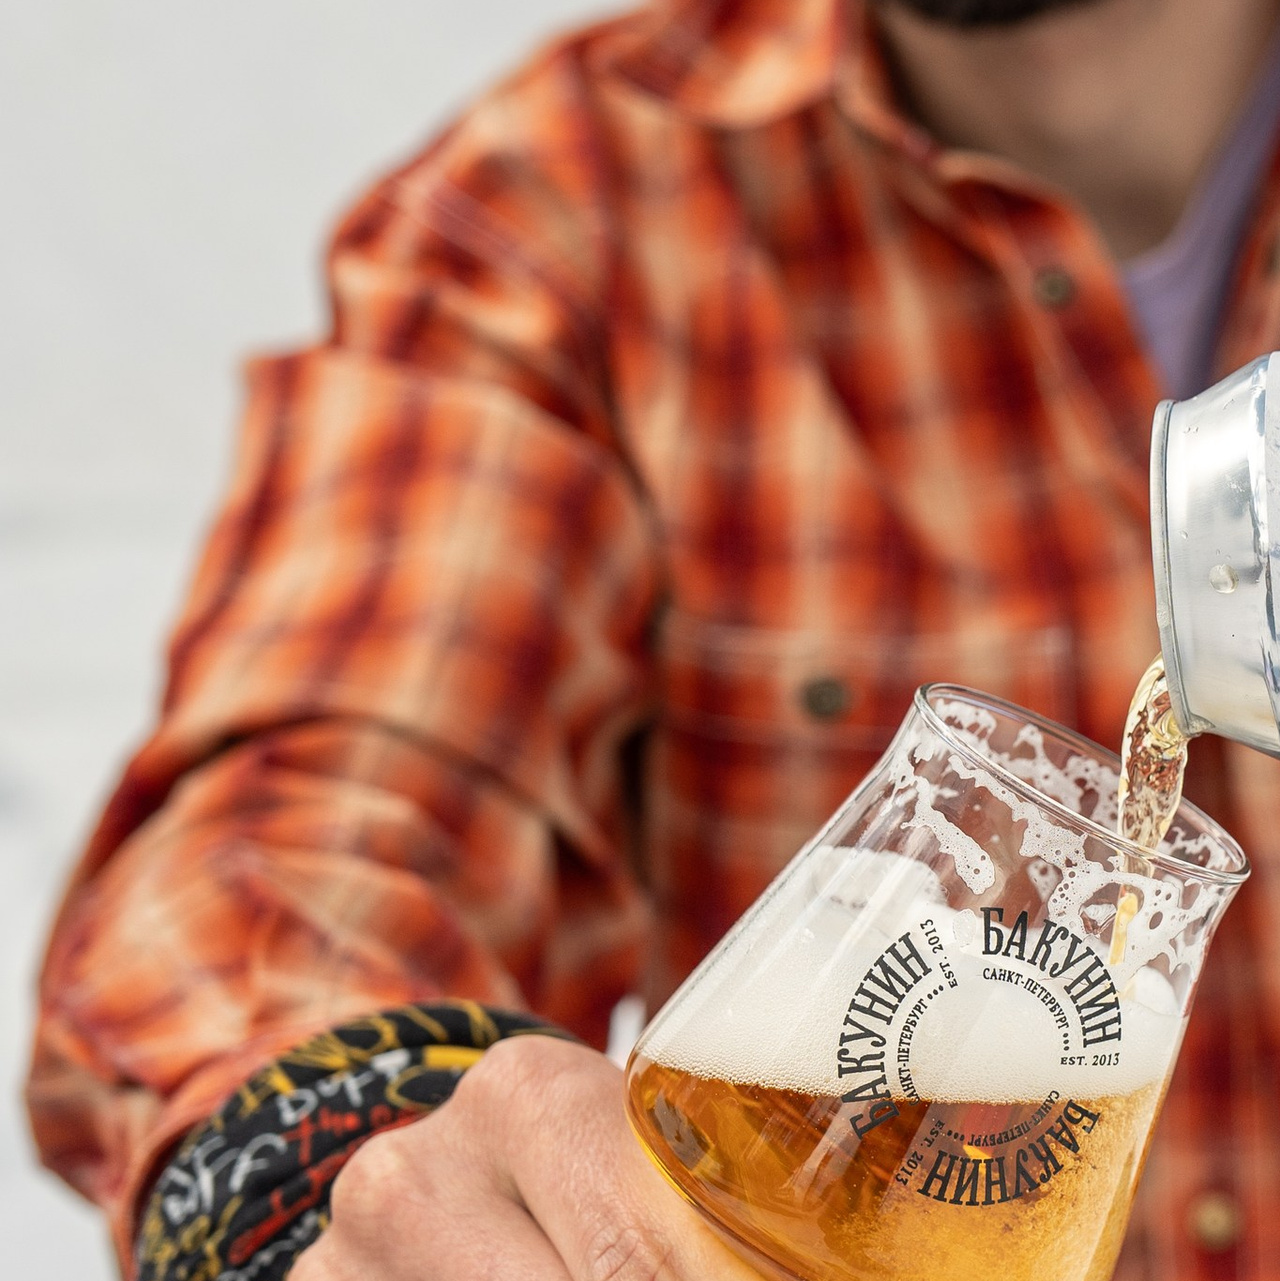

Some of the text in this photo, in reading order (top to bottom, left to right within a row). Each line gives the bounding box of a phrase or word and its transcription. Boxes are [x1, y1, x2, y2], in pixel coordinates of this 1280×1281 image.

[919, 918, 959, 989] EST. 2013
[980, 906, 1122, 1048] БАКУНИН
[982, 967, 1070, 1030] САНКТ-ПЕТЕРБУРГ
[837, 931, 933, 1140] БАКУНИН
[897, 997, 928, 1107] САНКТ-ПЕТЕРБУРГ
[1059, 1052, 1121, 1066] EST. 2013
[895, 1119, 946, 1187] EST. 2013
[916, 1099, 1101, 1207] БАКУНИН
[967, 1089, 1060, 1148] САНКТ-ПЕТЕРБУРГ
